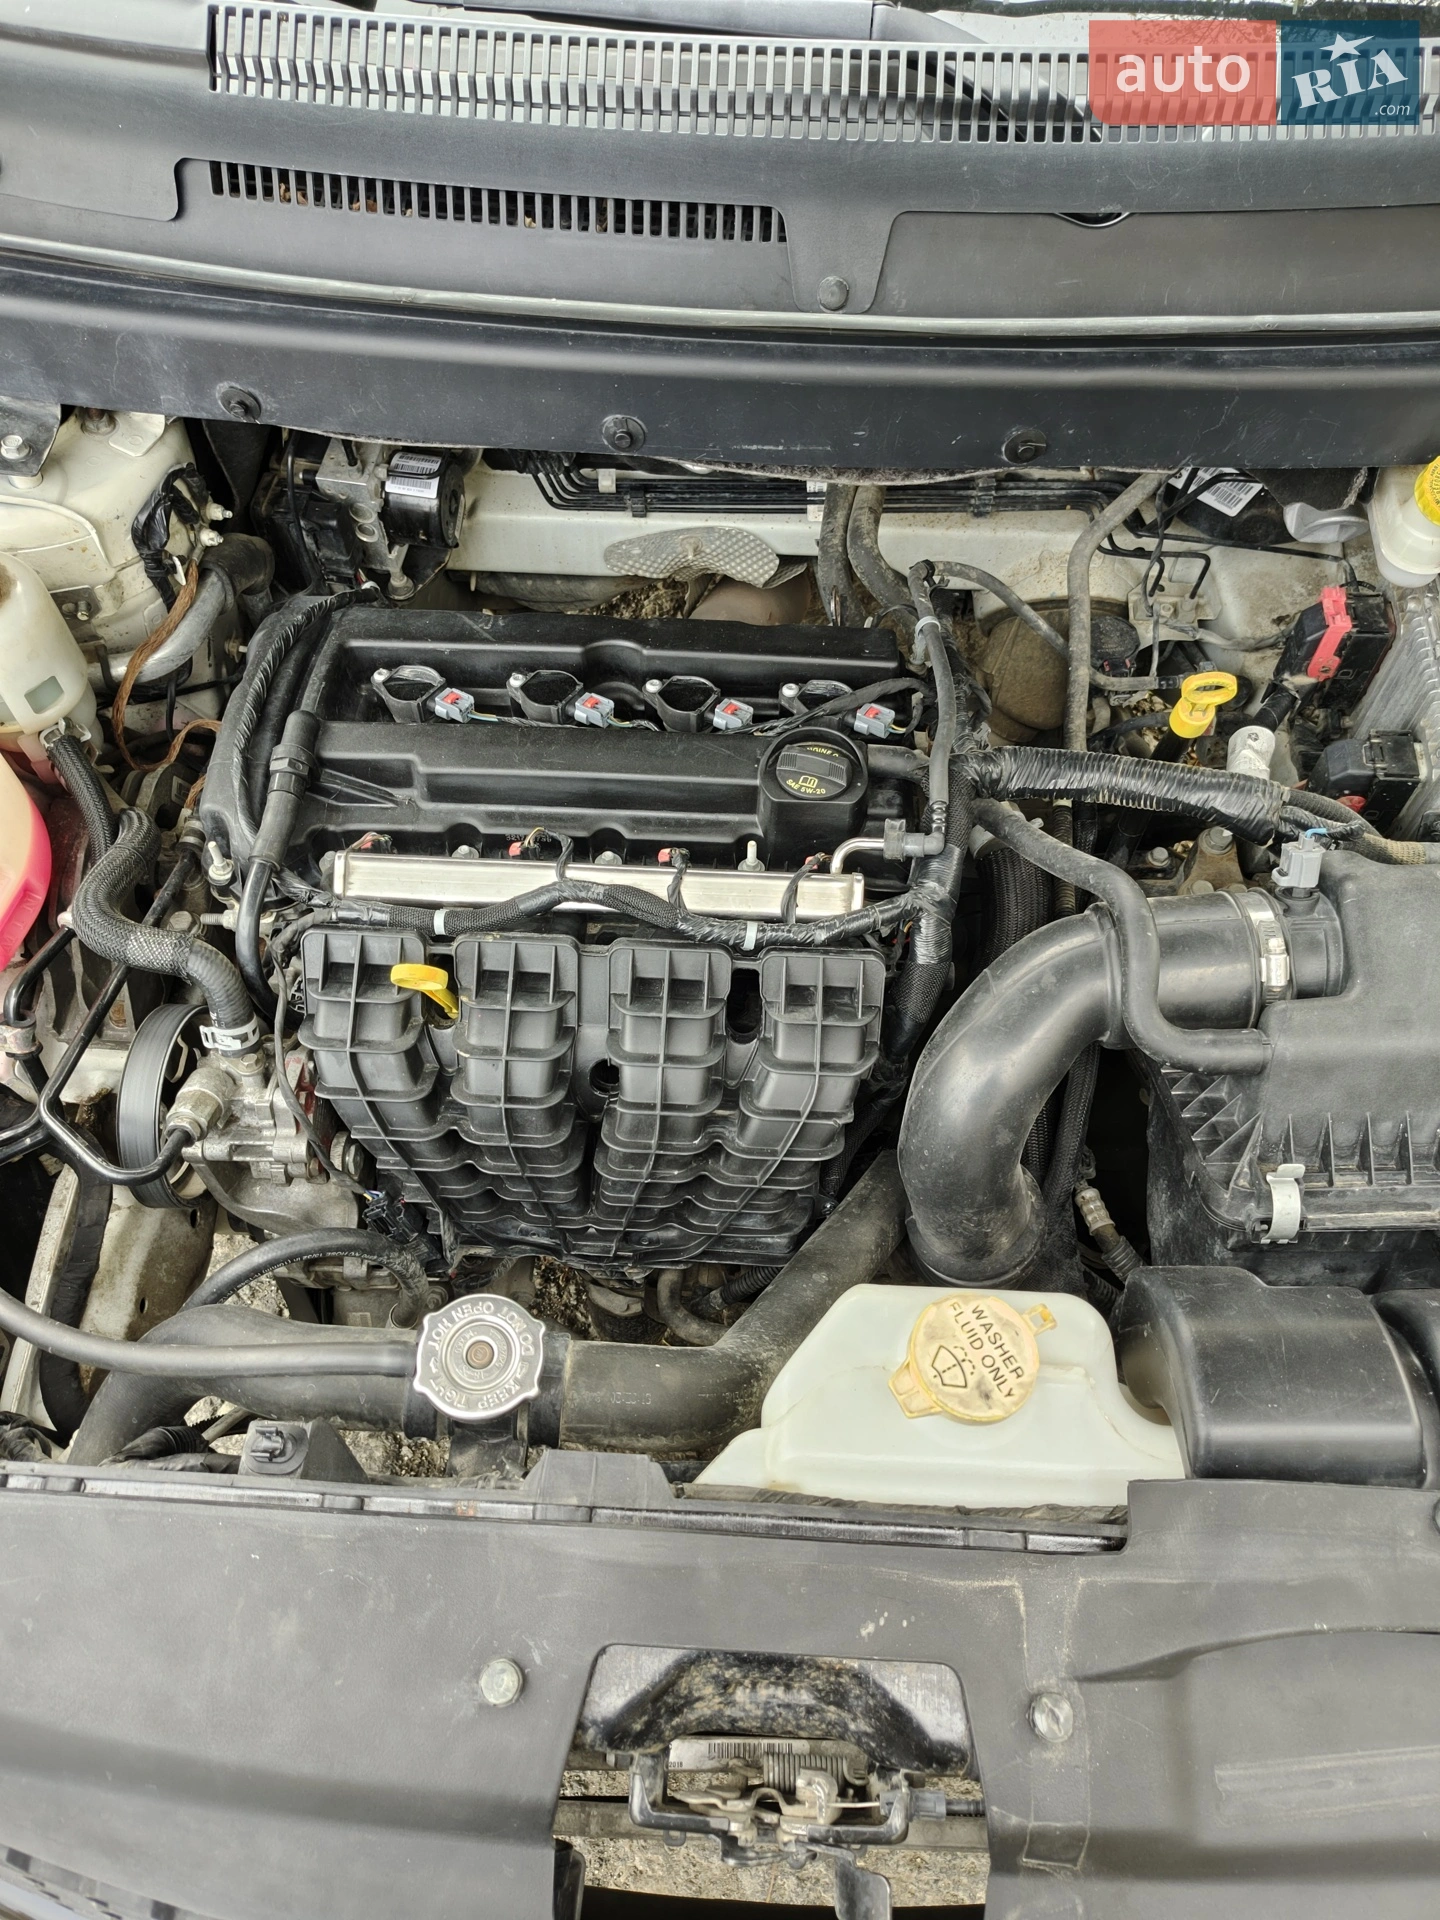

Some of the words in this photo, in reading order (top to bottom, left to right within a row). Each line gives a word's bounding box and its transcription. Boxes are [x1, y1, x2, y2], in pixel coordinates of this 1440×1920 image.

[786, 779, 800, 790] SAE
[800, 786, 826, 795] 5W-20
[451, 1301, 494, 1322] OPEN
[498, 1306, 527, 1333] NOT
[428, 1317, 452, 1351] HOT
[519, 1333, 535, 1356] DO
[971, 1304, 1026, 1380] WASHER
[949, 1301, 984, 1351] FLUID
[981, 1354, 1016, 1399] ONLY
[430, 1378, 467, 1409] TIGHT
[478, 1379, 520, 1409] KEEP
